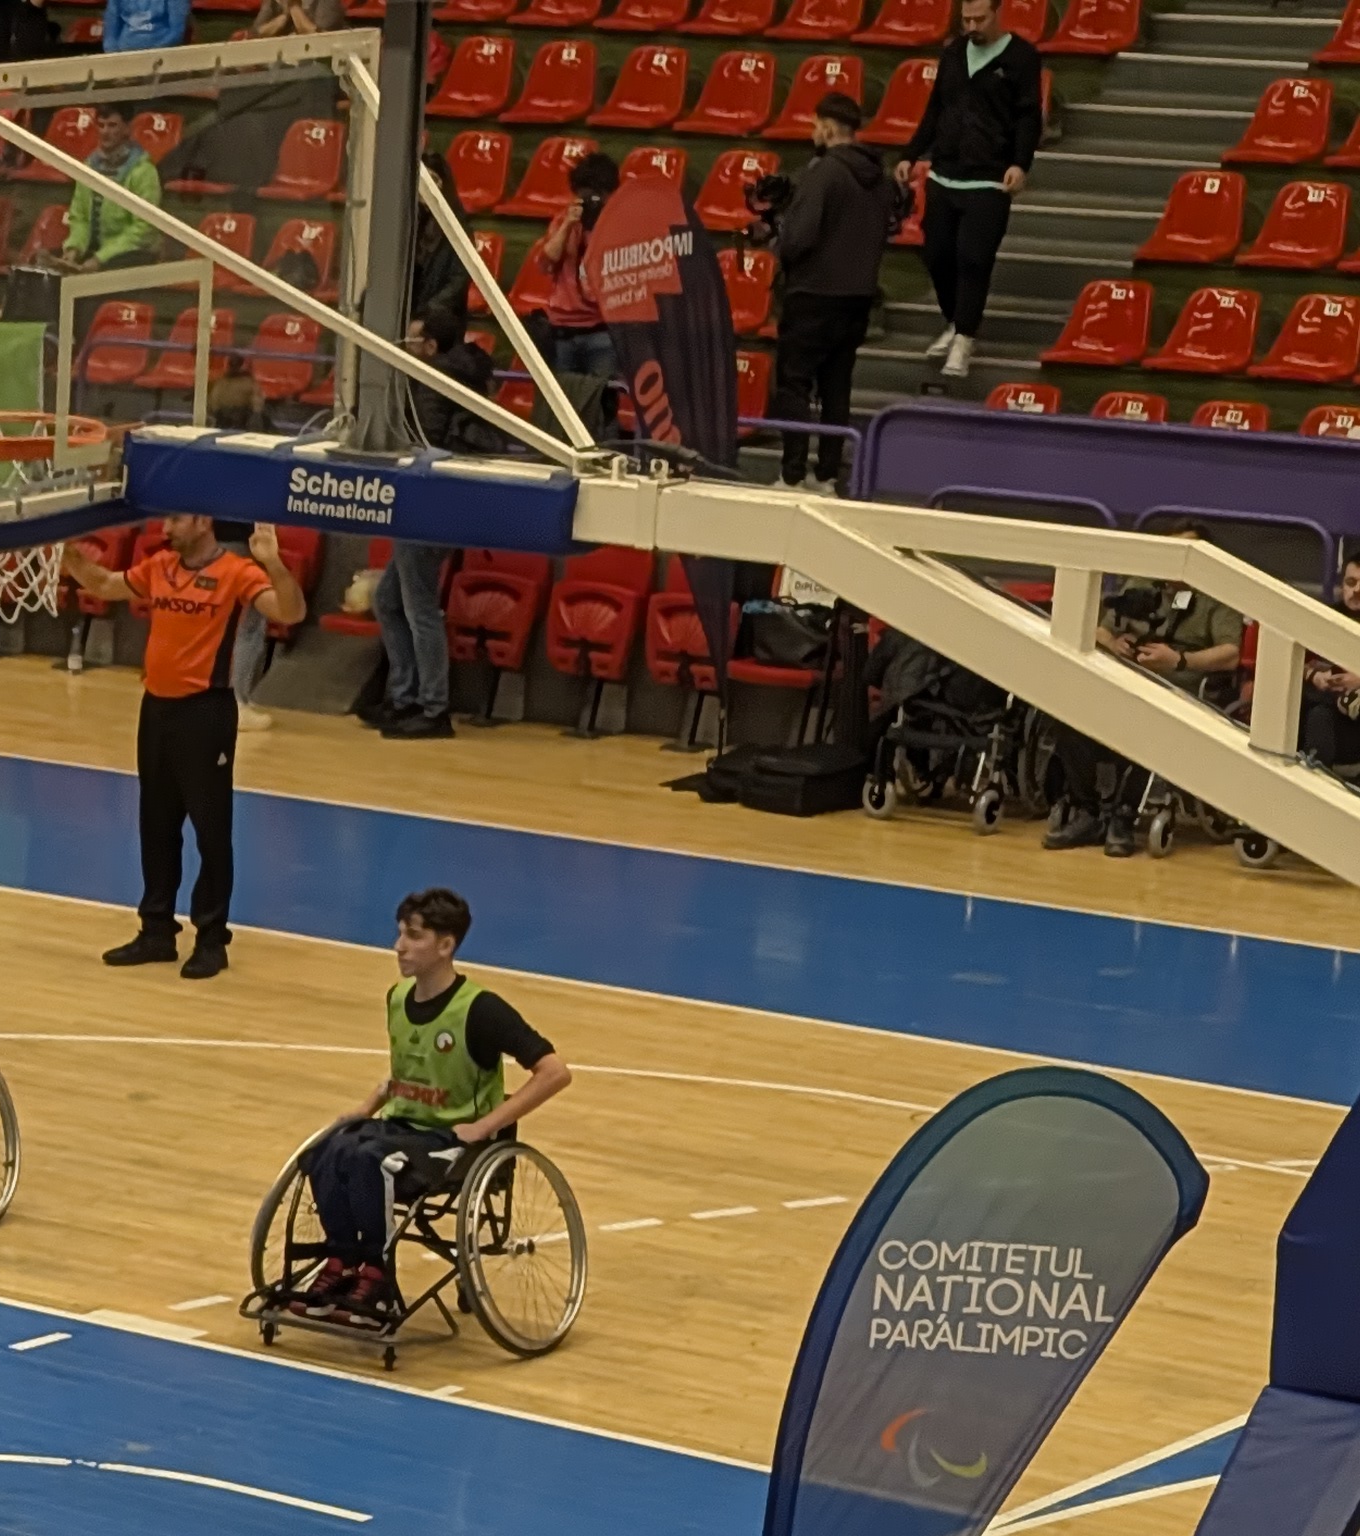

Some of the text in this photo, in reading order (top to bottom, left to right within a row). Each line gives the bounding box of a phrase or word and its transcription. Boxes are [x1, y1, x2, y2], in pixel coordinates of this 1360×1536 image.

[289, 467, 396, 505] Schelde
[287, 495, 393, 525] International
[878, 1239, 1094, 1280] COMITETUL
